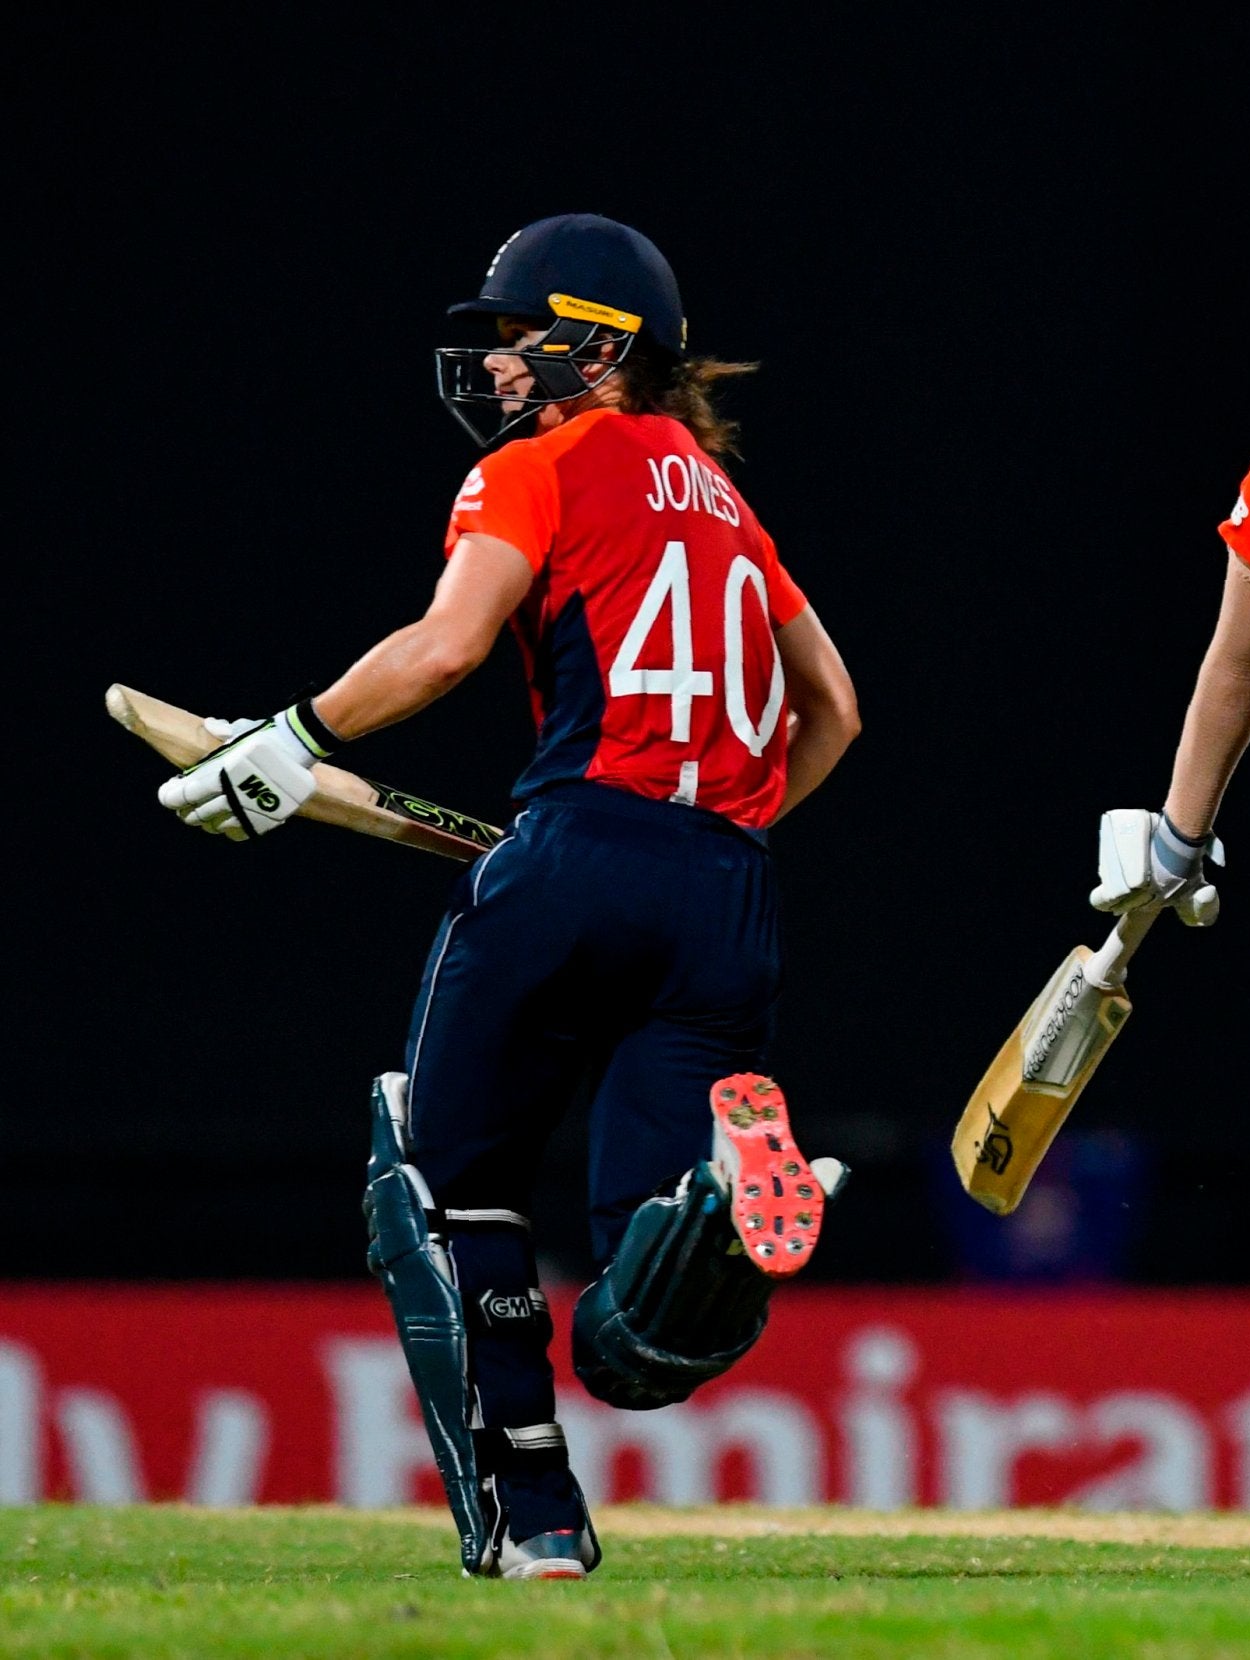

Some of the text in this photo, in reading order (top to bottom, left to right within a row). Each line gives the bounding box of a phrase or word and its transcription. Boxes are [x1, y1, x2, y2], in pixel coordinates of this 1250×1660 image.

[646, 453, 741, 528] JONES
[608, 540, 786, 758] 40
[238, 773, 281, 813] GM
[488, 1295, 532, 1320] GM
